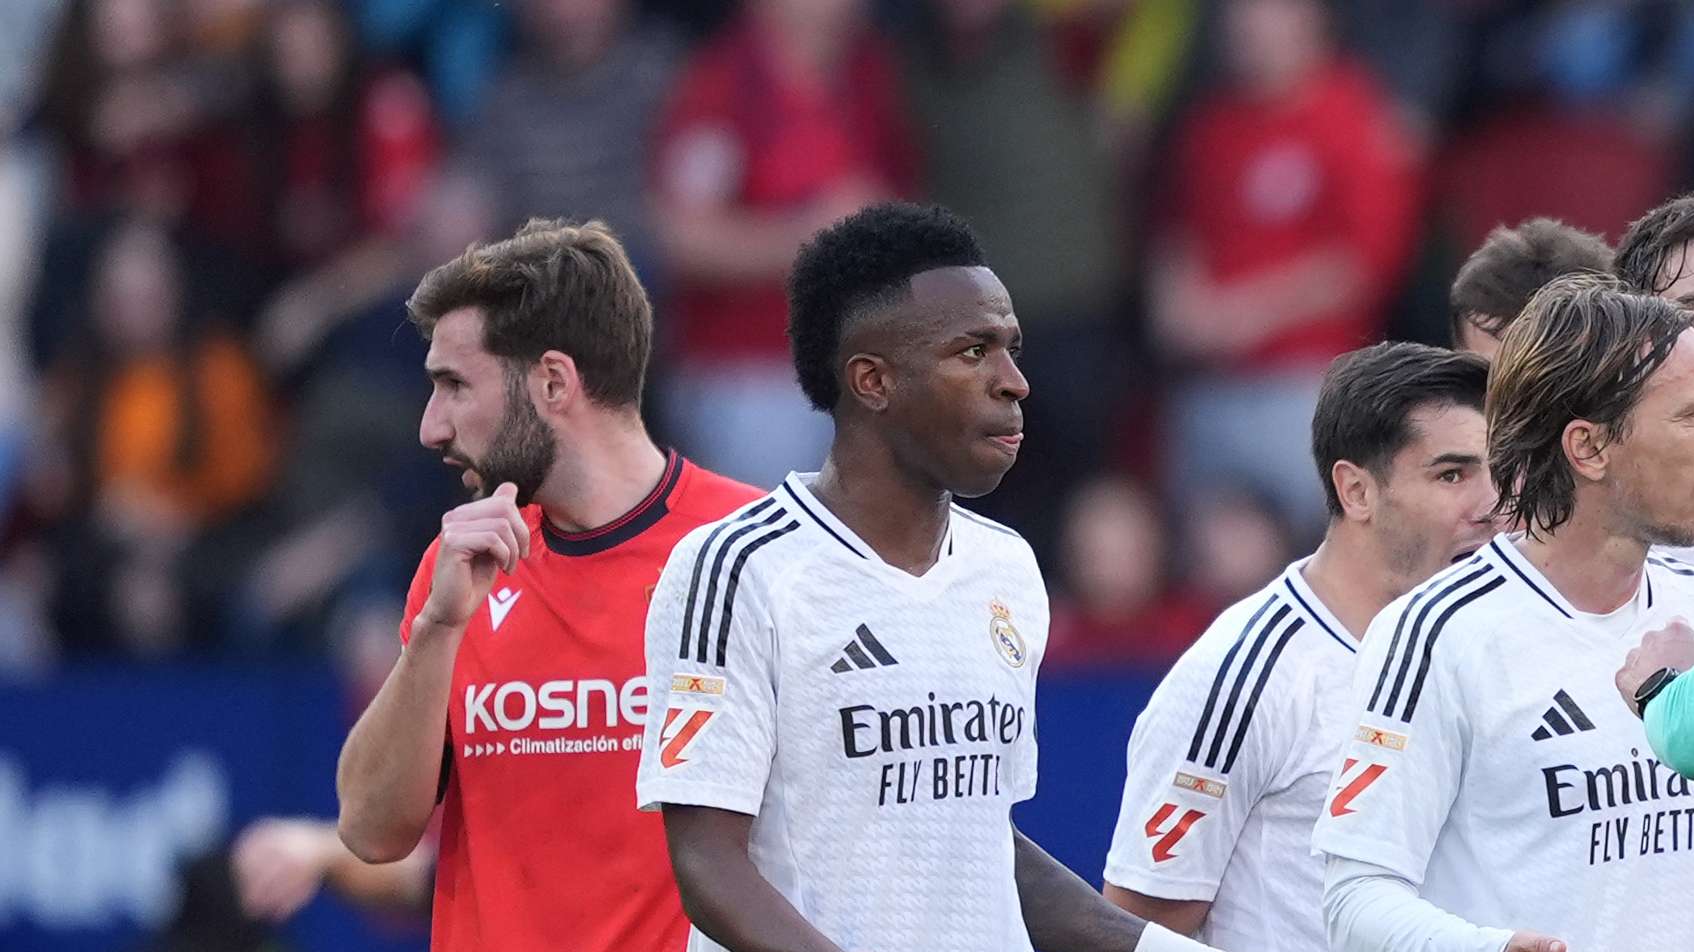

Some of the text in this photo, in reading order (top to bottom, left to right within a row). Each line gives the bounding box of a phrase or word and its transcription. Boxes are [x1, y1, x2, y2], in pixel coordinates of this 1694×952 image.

[510, 733, 643, 755] Climatización efi
[838, 691, 1025, 758] Emirates
[879, 760, 922, 806] FLY
[1590, 817, 1629, 865] FLY
